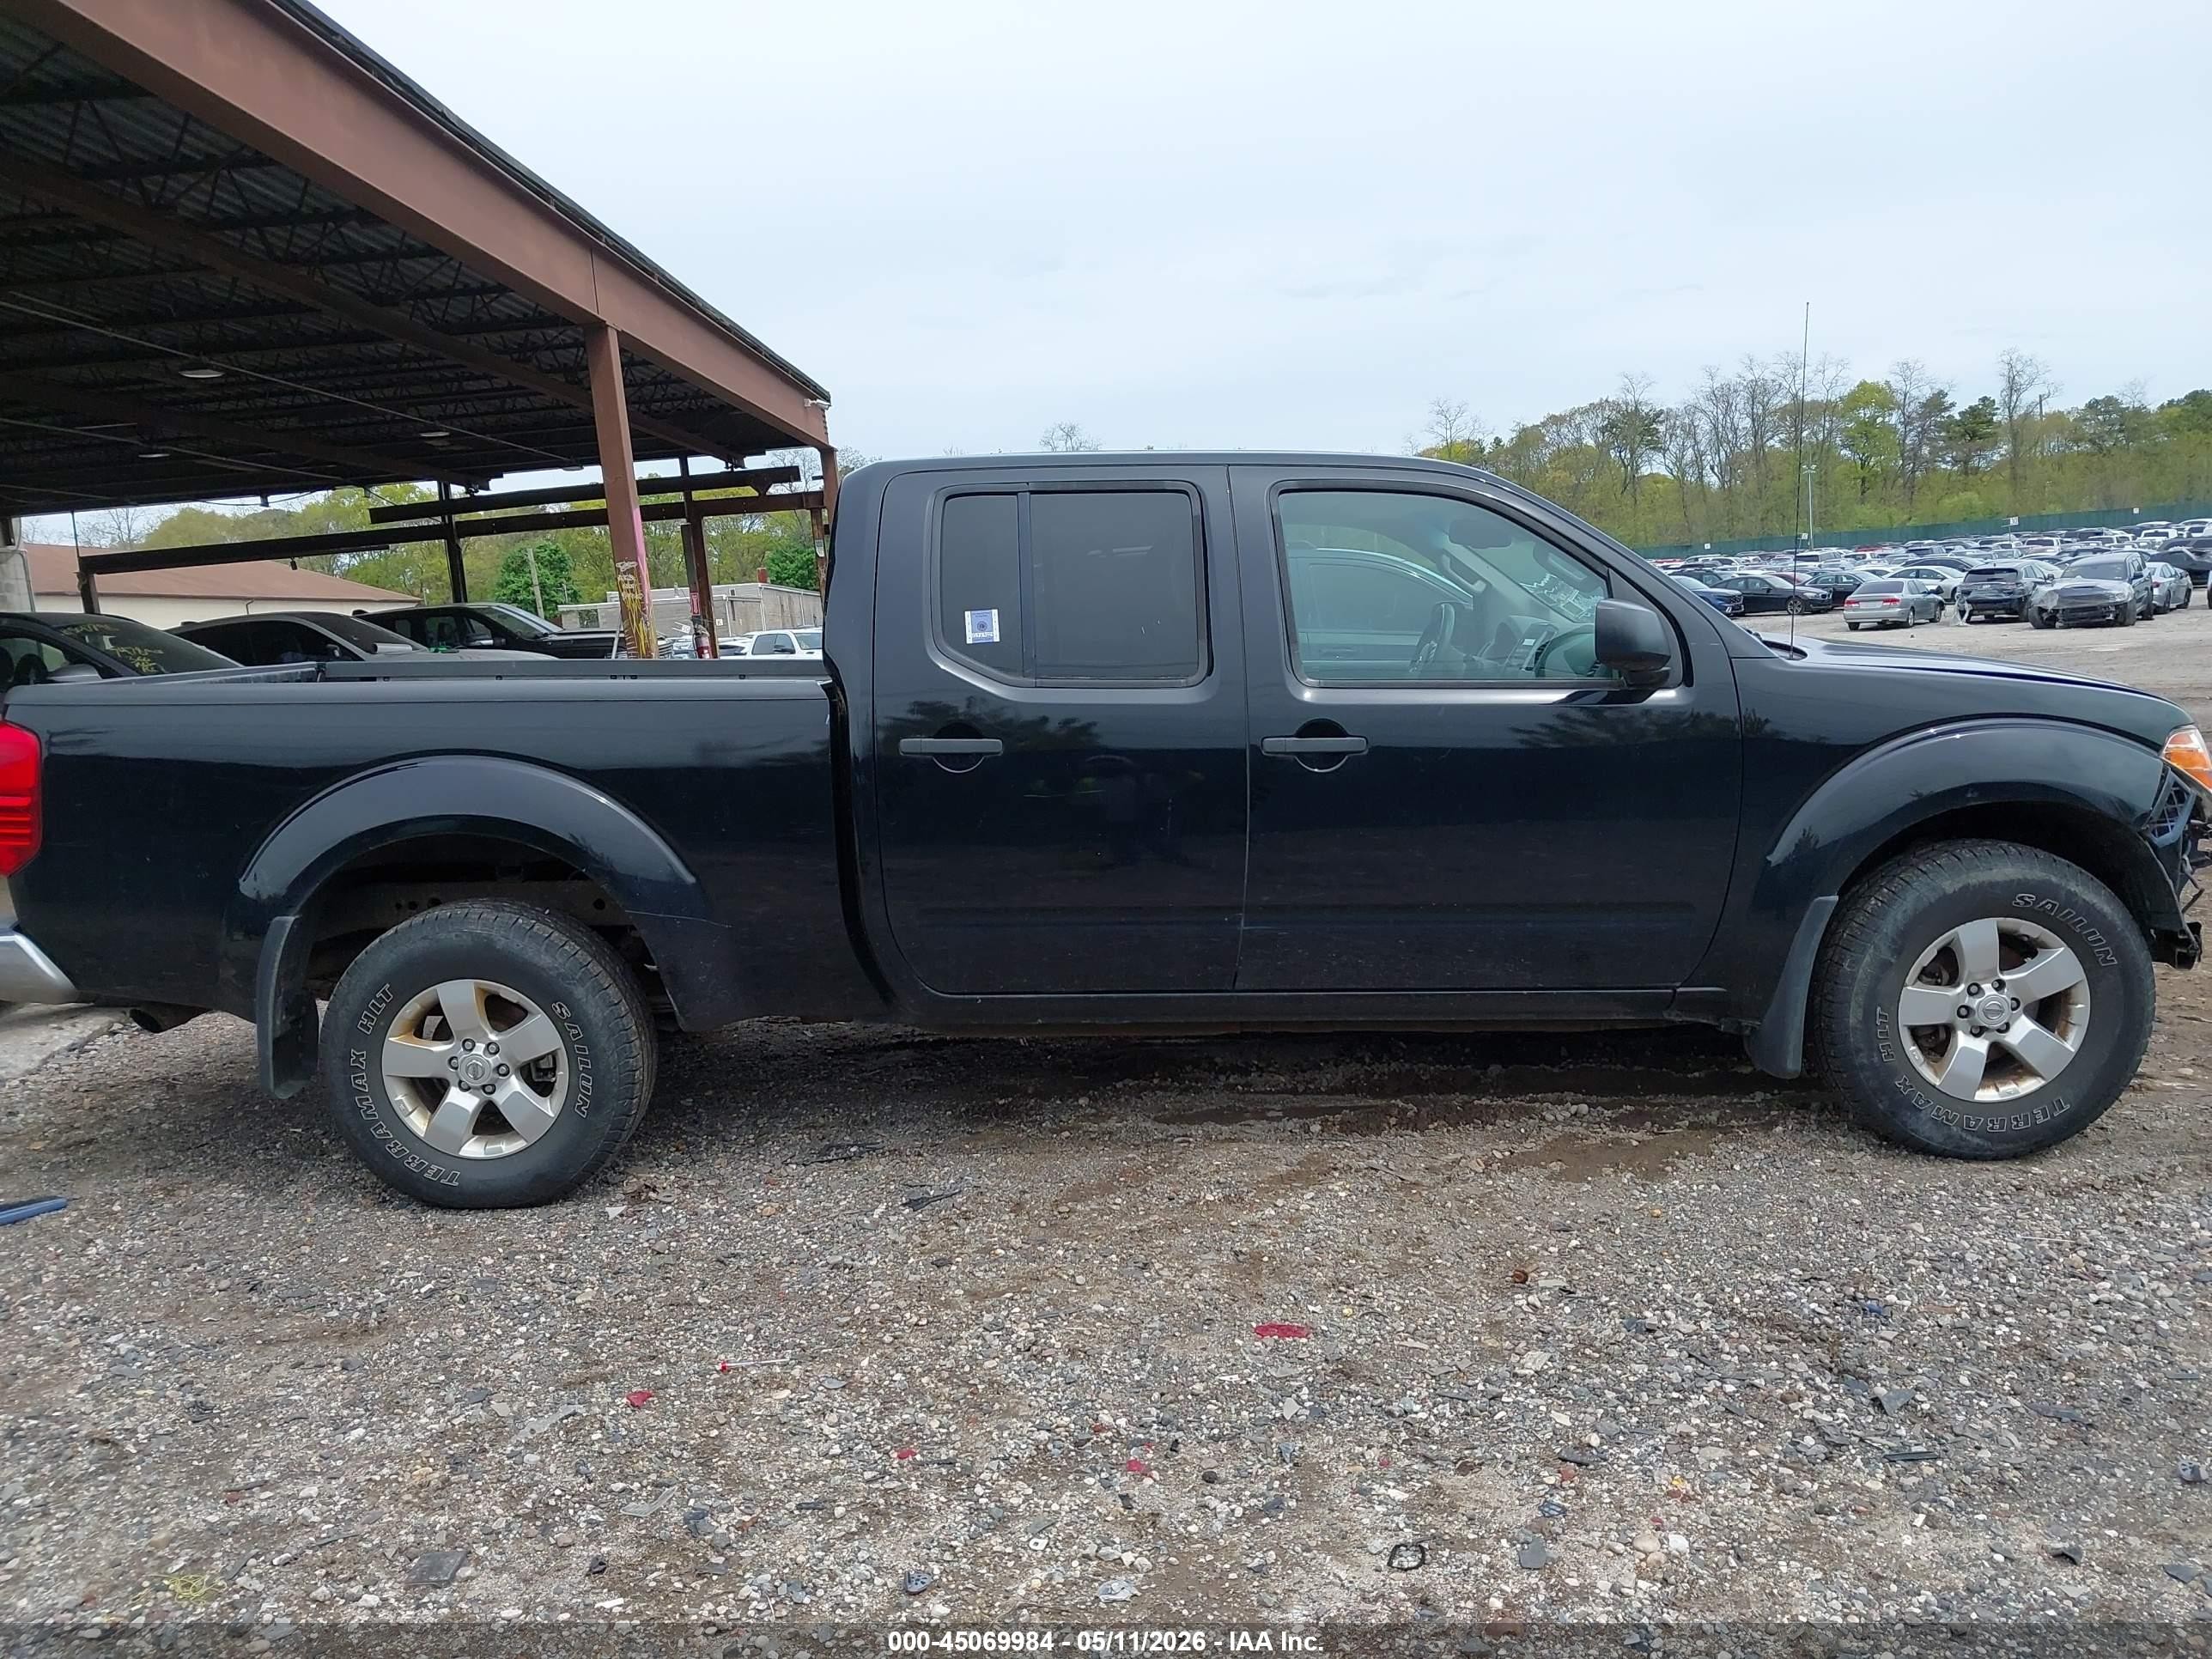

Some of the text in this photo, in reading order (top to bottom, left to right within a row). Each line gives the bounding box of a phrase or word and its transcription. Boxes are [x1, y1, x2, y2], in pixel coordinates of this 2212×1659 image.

[2012, 893, 2120, 968] SAILUN
[349, 983, 461, 1188] TERRAMAX HLT
[551, 1001, 594, 1118] SAILUN
[1875, 1006, 2072, 1133] TERRAMAX HLT
